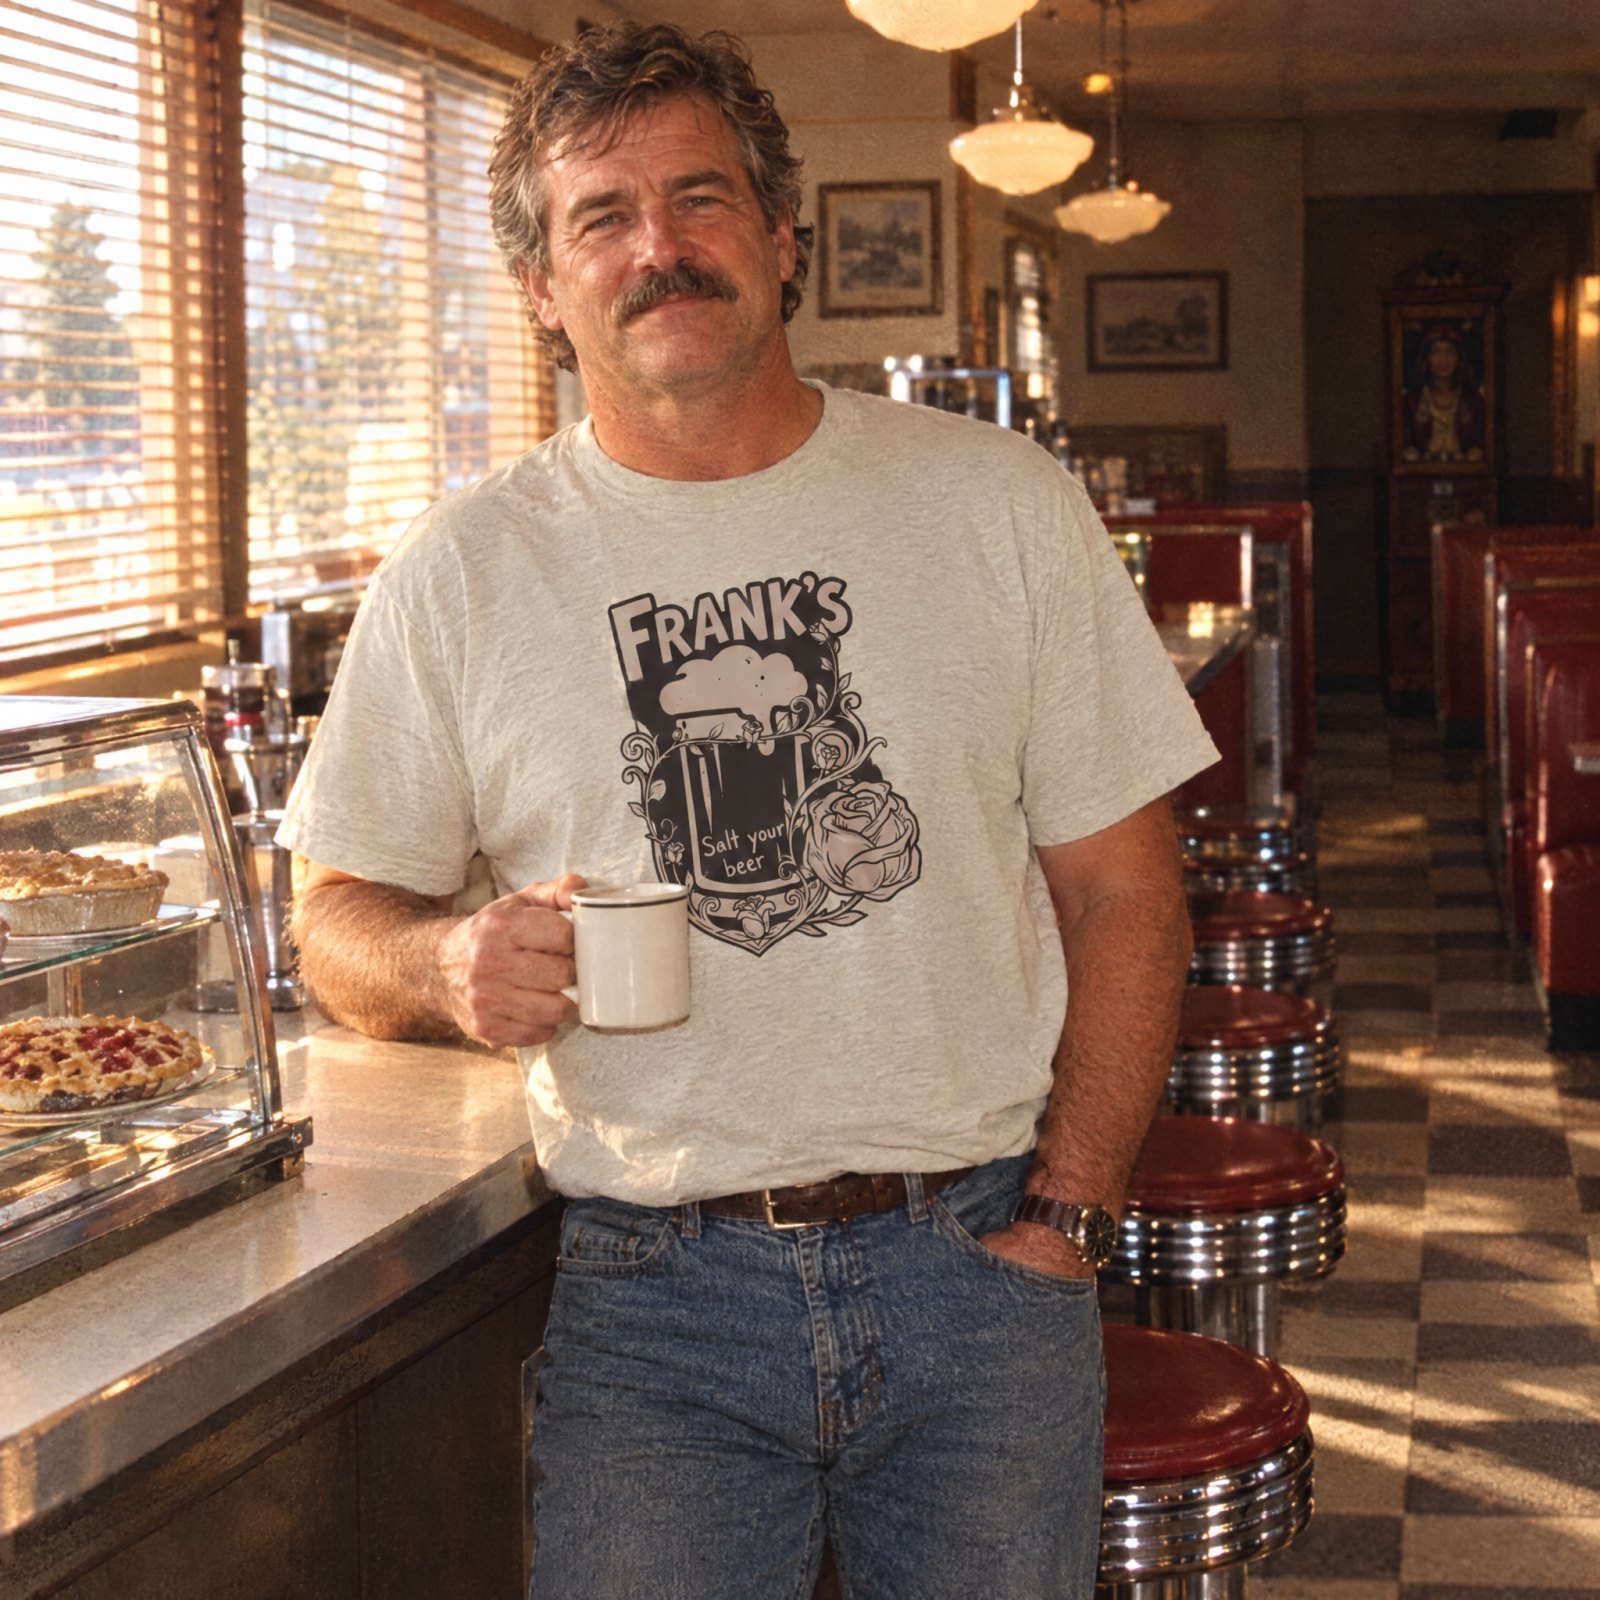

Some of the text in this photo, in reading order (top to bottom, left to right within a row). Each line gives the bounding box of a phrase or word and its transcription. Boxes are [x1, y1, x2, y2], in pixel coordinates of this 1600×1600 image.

[609, 572, 851, 682] FRANK'S
[702, 823, 785, 857] Salt your
[723, 855, 765, 878] beer
